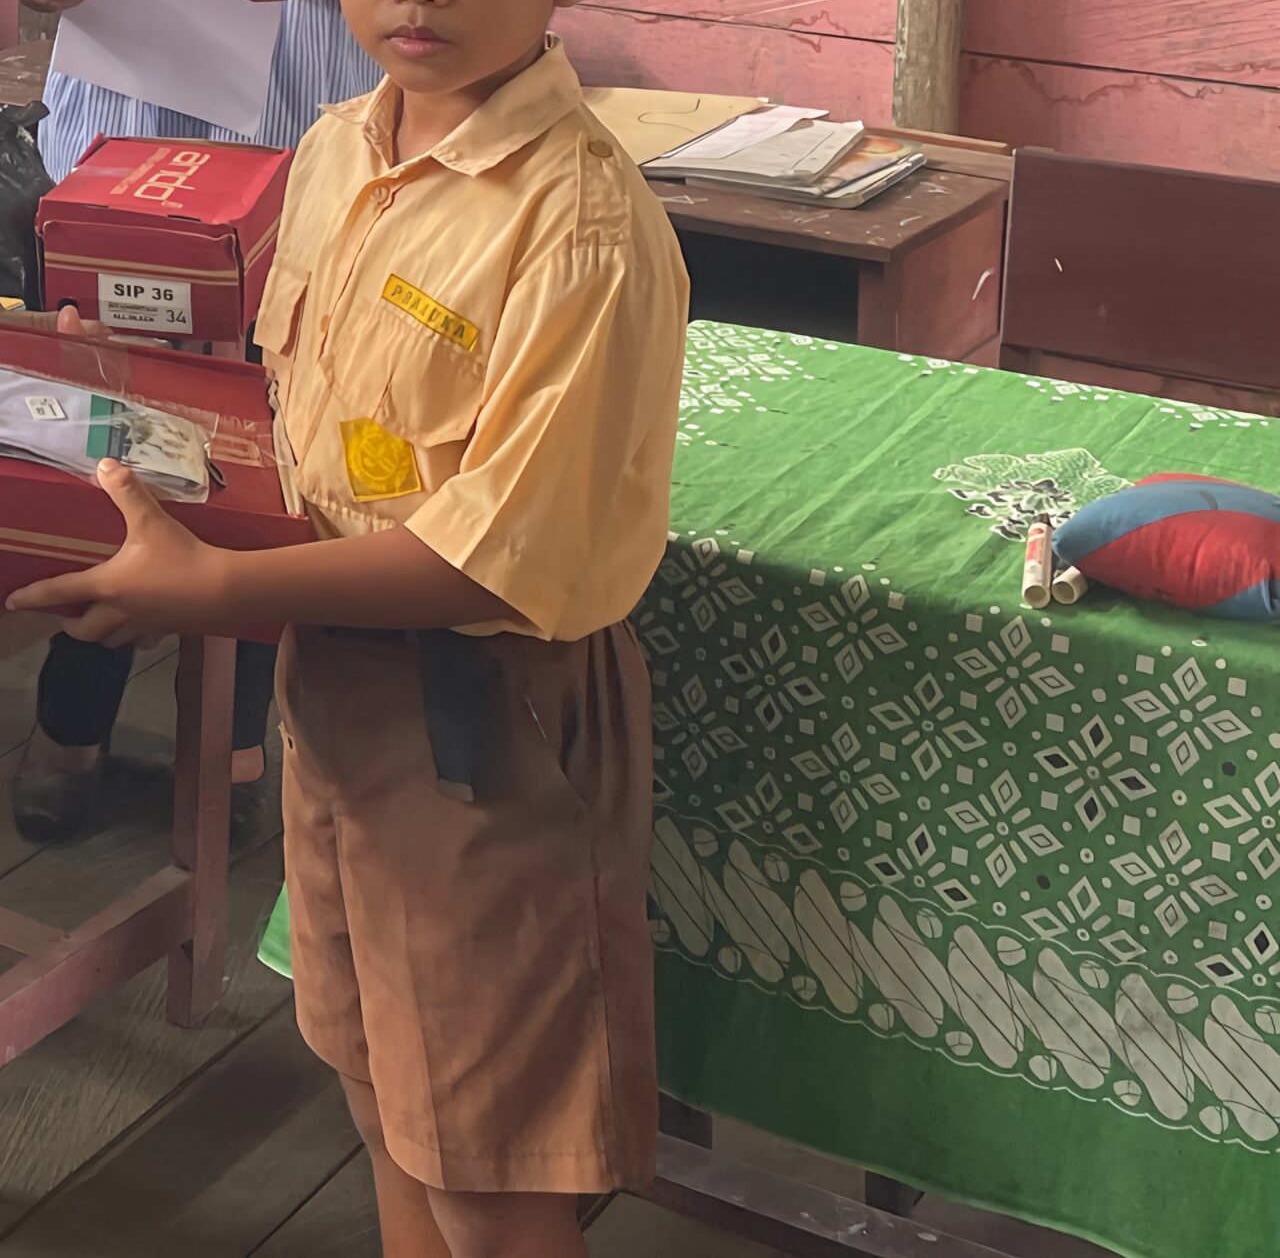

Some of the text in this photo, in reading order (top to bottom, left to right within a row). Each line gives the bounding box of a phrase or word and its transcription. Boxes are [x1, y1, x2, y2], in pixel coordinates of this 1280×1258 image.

[113, 283, 174, 302] SIP 36
[166, 309, 187, 325] 34
